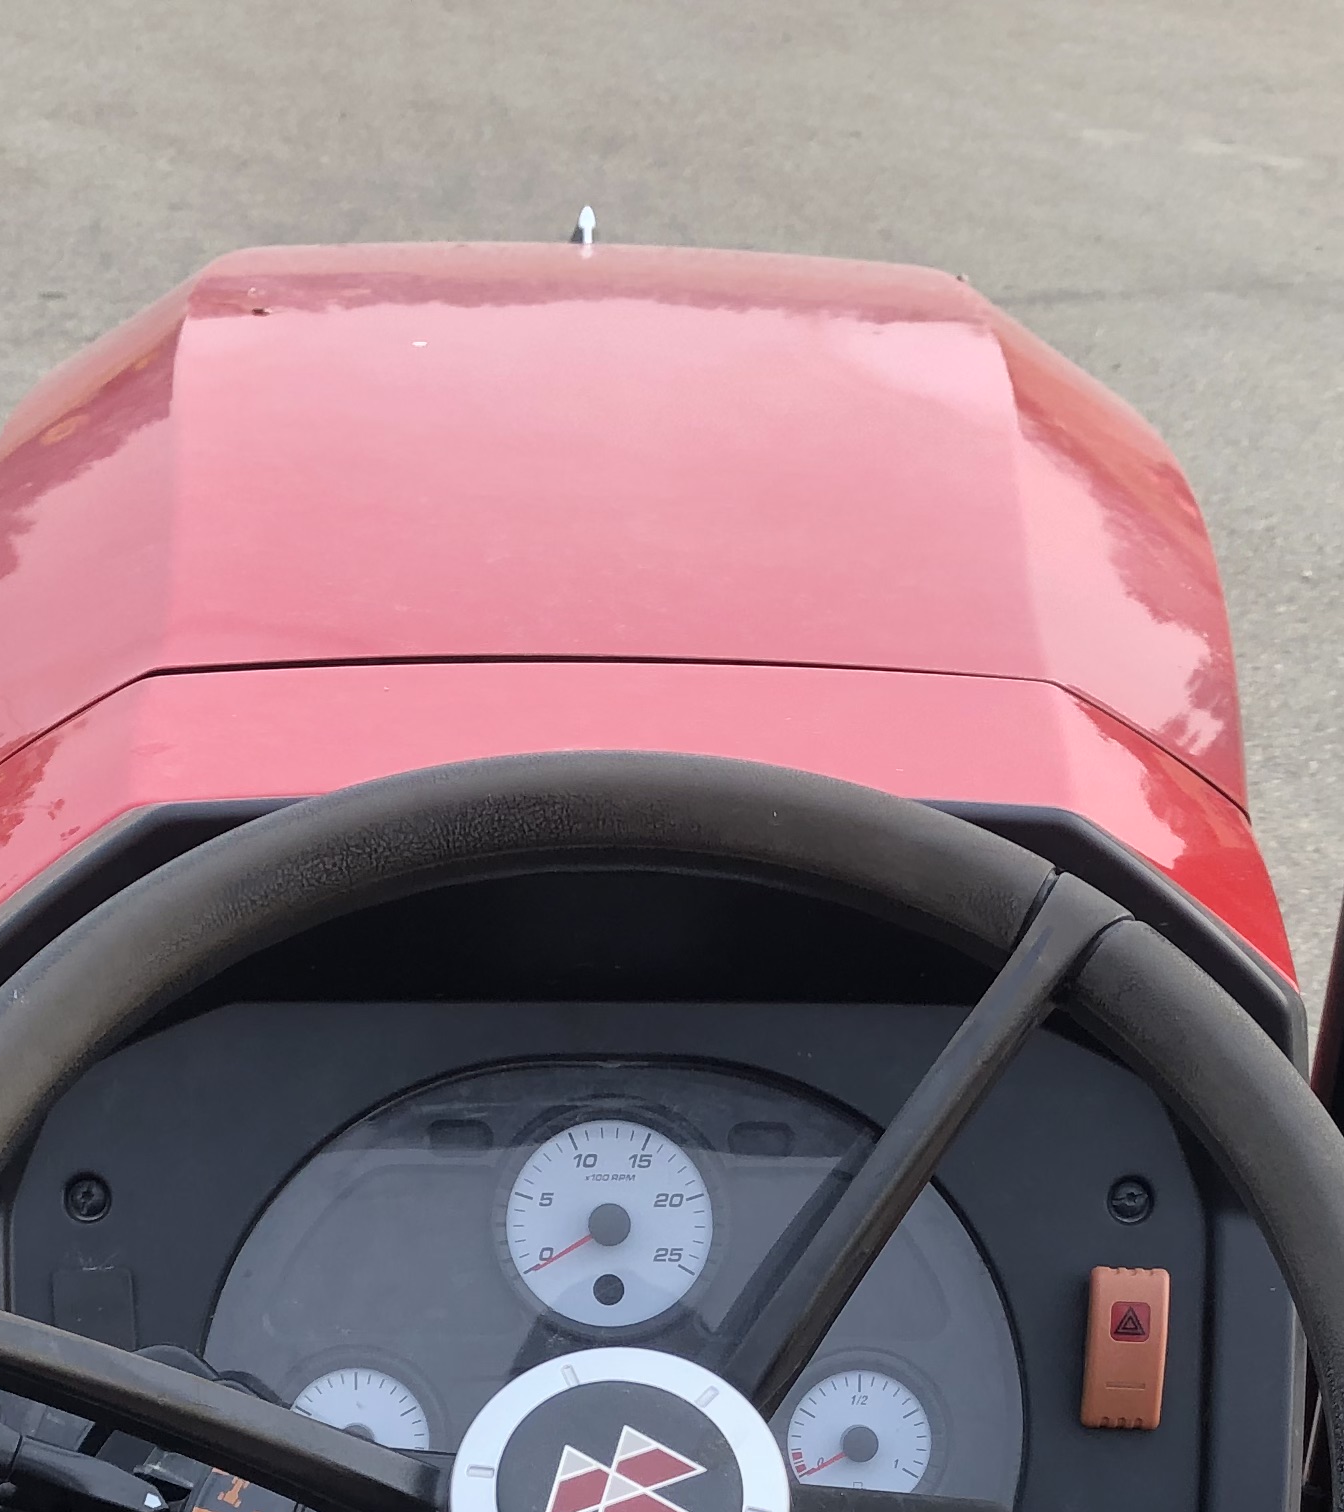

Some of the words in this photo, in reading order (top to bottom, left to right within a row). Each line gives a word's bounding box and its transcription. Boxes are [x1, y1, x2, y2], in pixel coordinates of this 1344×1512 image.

[573, 1154, 598, 1168] 10
[628, 1154, 653, 1168] 15
[538, 1192, 554, 1207] 5
[653, 1193, 684, 1208] 20
[538, 1247, 554, 1261] 0
[653, 1248, 683, 1262] 25
[850, 1395, 869, 1406] 1/2
[893, 1458, 899, 1468] 1
